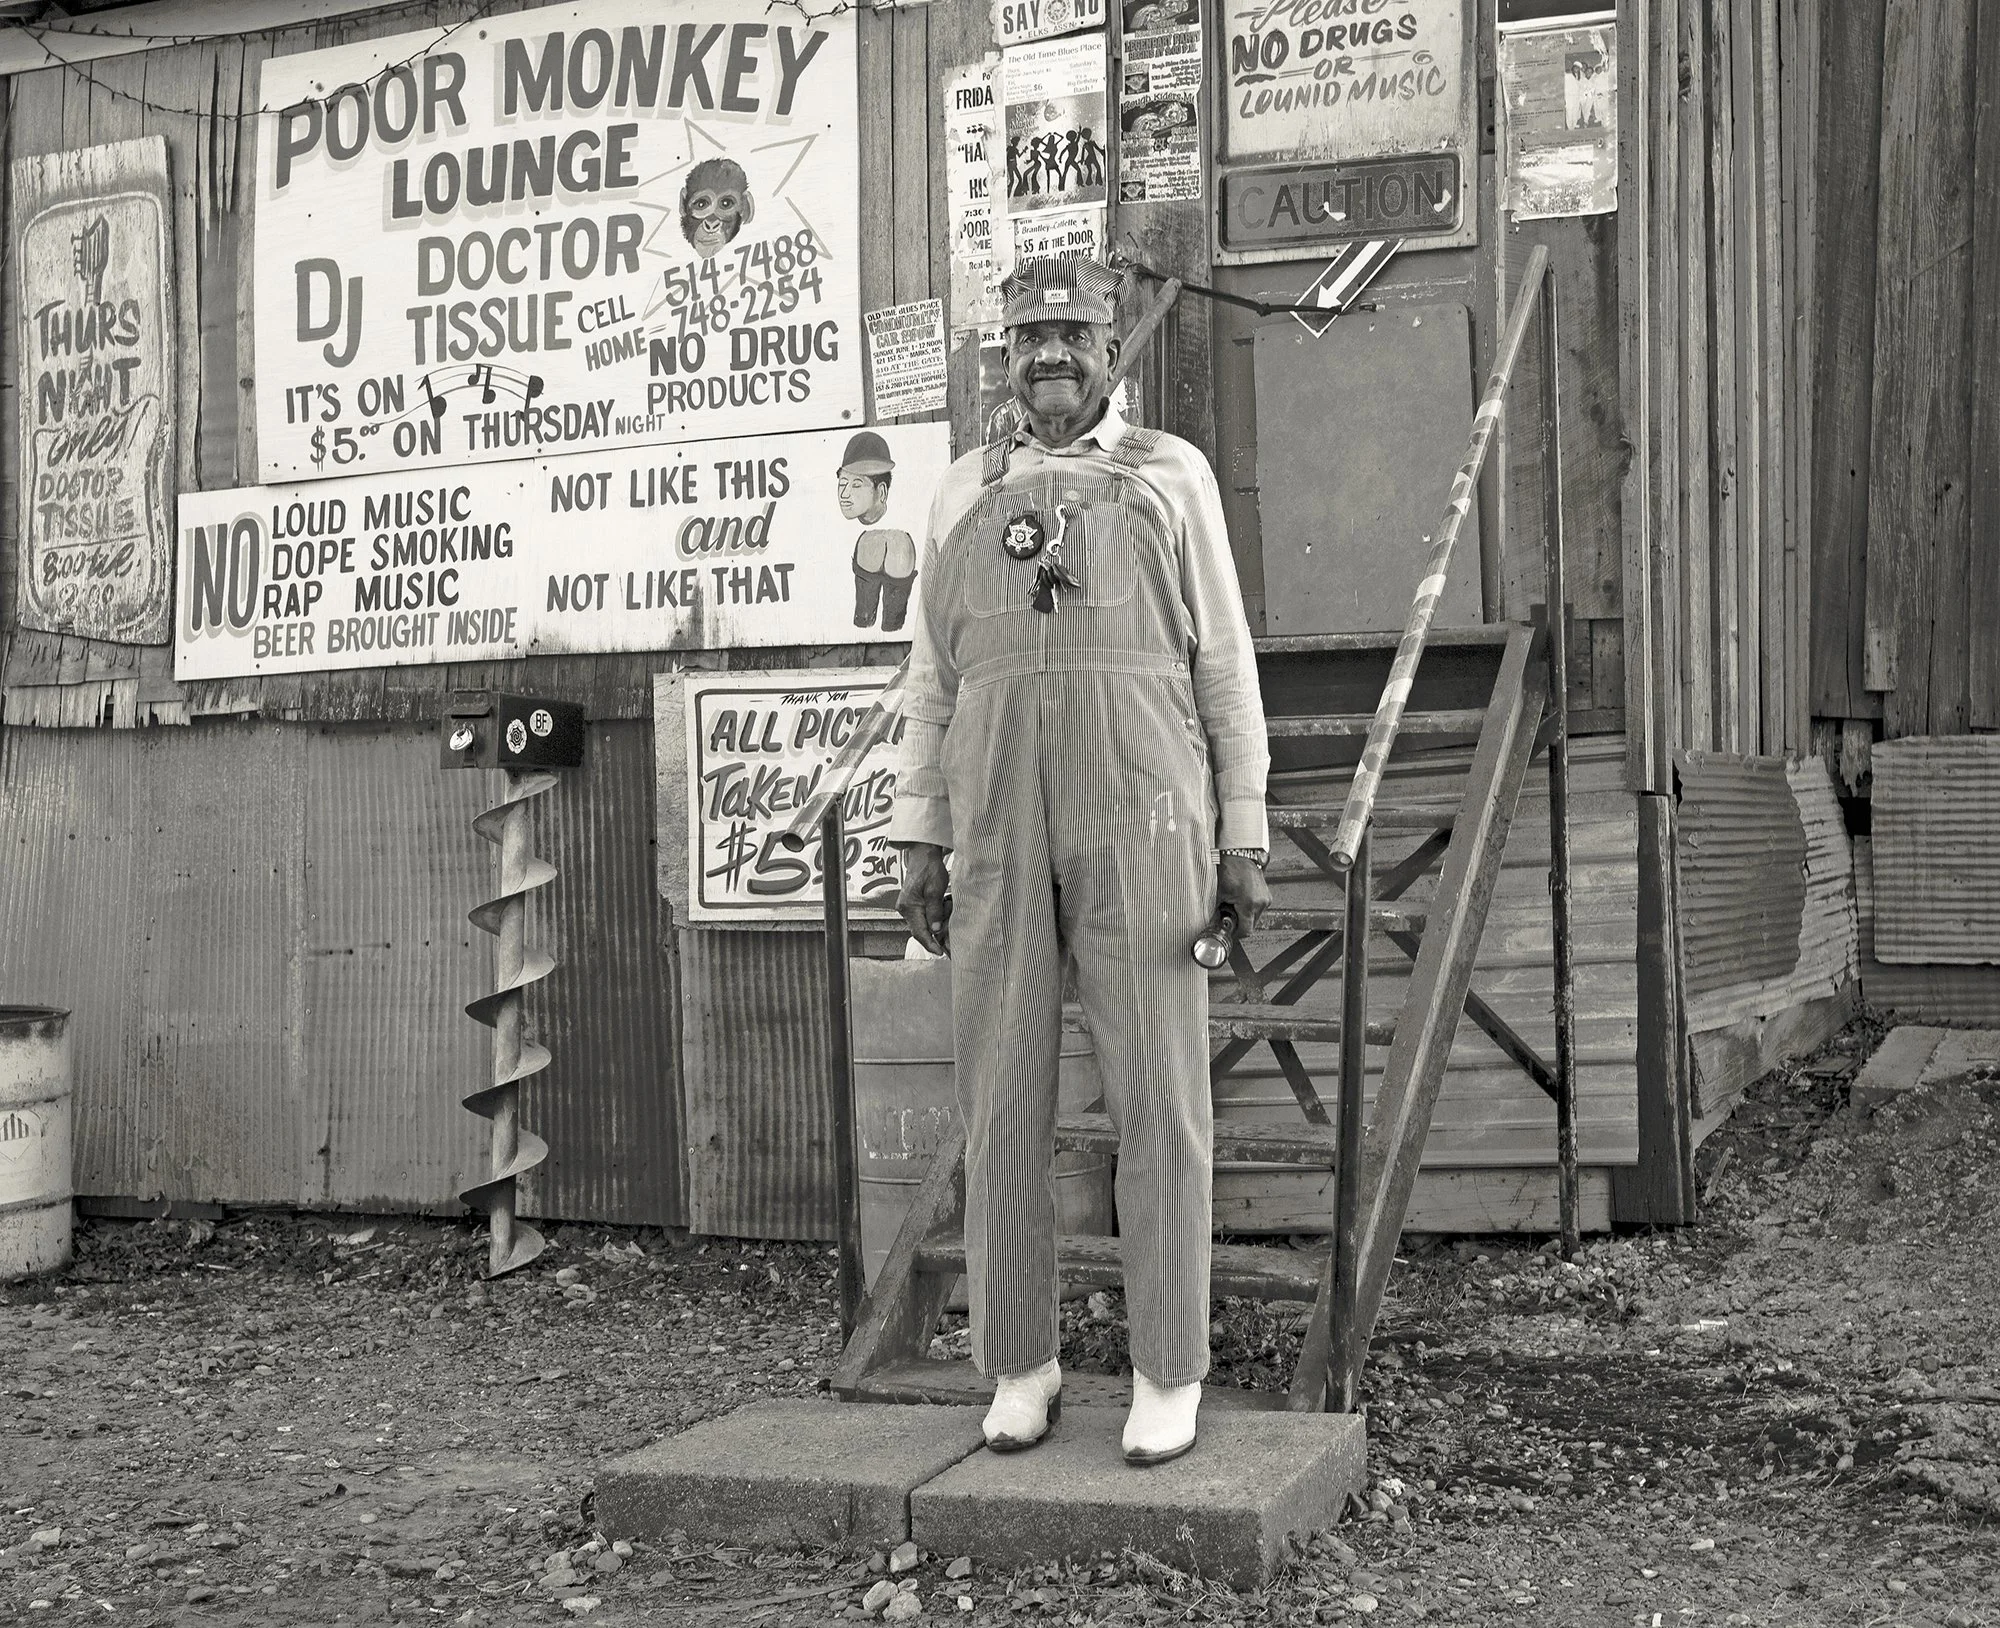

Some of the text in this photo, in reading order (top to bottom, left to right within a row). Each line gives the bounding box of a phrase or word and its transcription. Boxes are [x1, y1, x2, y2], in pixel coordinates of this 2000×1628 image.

[1002, 1, 1041, 35] SAY
[1027, 27, 1049, 39] ELKS
[1008, 55, 1022, 64] The
[1022, 52, 1036, 62] Old
[1038, 51, 1057, 60] Time
[1057, 47, 1079, 57] Blues
[1079, 43, 1102, 52] Place
[1232, 28, 1290, 78] NO
[1299, 13, 1418, 59] DRUGS
[1313, 55, 1356, 81] OR
[275, 22, 829, 190] POOR MONKEY
[956, 84, 994, 111] FRIDA
[1348, 65, 1447, 108] MUSIC
[390, 122, 640, 220] LOUNGE
[1237, 170, 1445, 230] CAUTION
[417, 212, 645, 297] DOCTOR
[1023, 229, 1094, 254] $5 AT THE DOOR
[664, 228, 818, 307] 514-7488
[294, 256, 364, 369] DJ
[405, 290, 573, 366] TISSUE
[576, 294, 636, 334] CELL
[670, 266, 824, 344] 748-2254
[867, 312, 881, 322] OLD
[898, 304, 919, 315] BLUES
[919, 300, 940, 311] PLACE
[33, 299, 141, 362] THURS
[584, 326, 648, 372] HOME
[649, 319, 839, 377] NO DRUG
[876, 323, 936, 350] CAR SHOW
[895, 345, 910, 355] JUNE
[926, 338, 943, 348] NOON
[285, 374, 405, 424] IT'S ON
[647, 368, 811, 416] PRODUCTS
[902, 377, 920, 387] PLACE
[309, 399, 666, 473] $5.00 ON THURSDAY NIGHT
[38, 467, 124, 503] DOCTOR
[550, 457, 790, 513] NOT LIKE THIS
[36, 497, 135, 542] TISSUE
[272, 485, 472, 540] LOUD MUSIC
[679, 500, 777, 557] and
[42, 551, 87, 587] 8:00
[191, 517, 260, 632] NO
[272, 521, 513, 581] DOPE SMOKING
[262, 567, 460, 620] RAP MUSIC
[546, 562, 795, 613] NOT LIKE THAT
[253, 606, 518, 659] BEER BROUGHT INSIDE
[535, 712, 549, 730] BF
[780, 692, 823, 706] THANK
[710, 709, 783, 753] ALL
